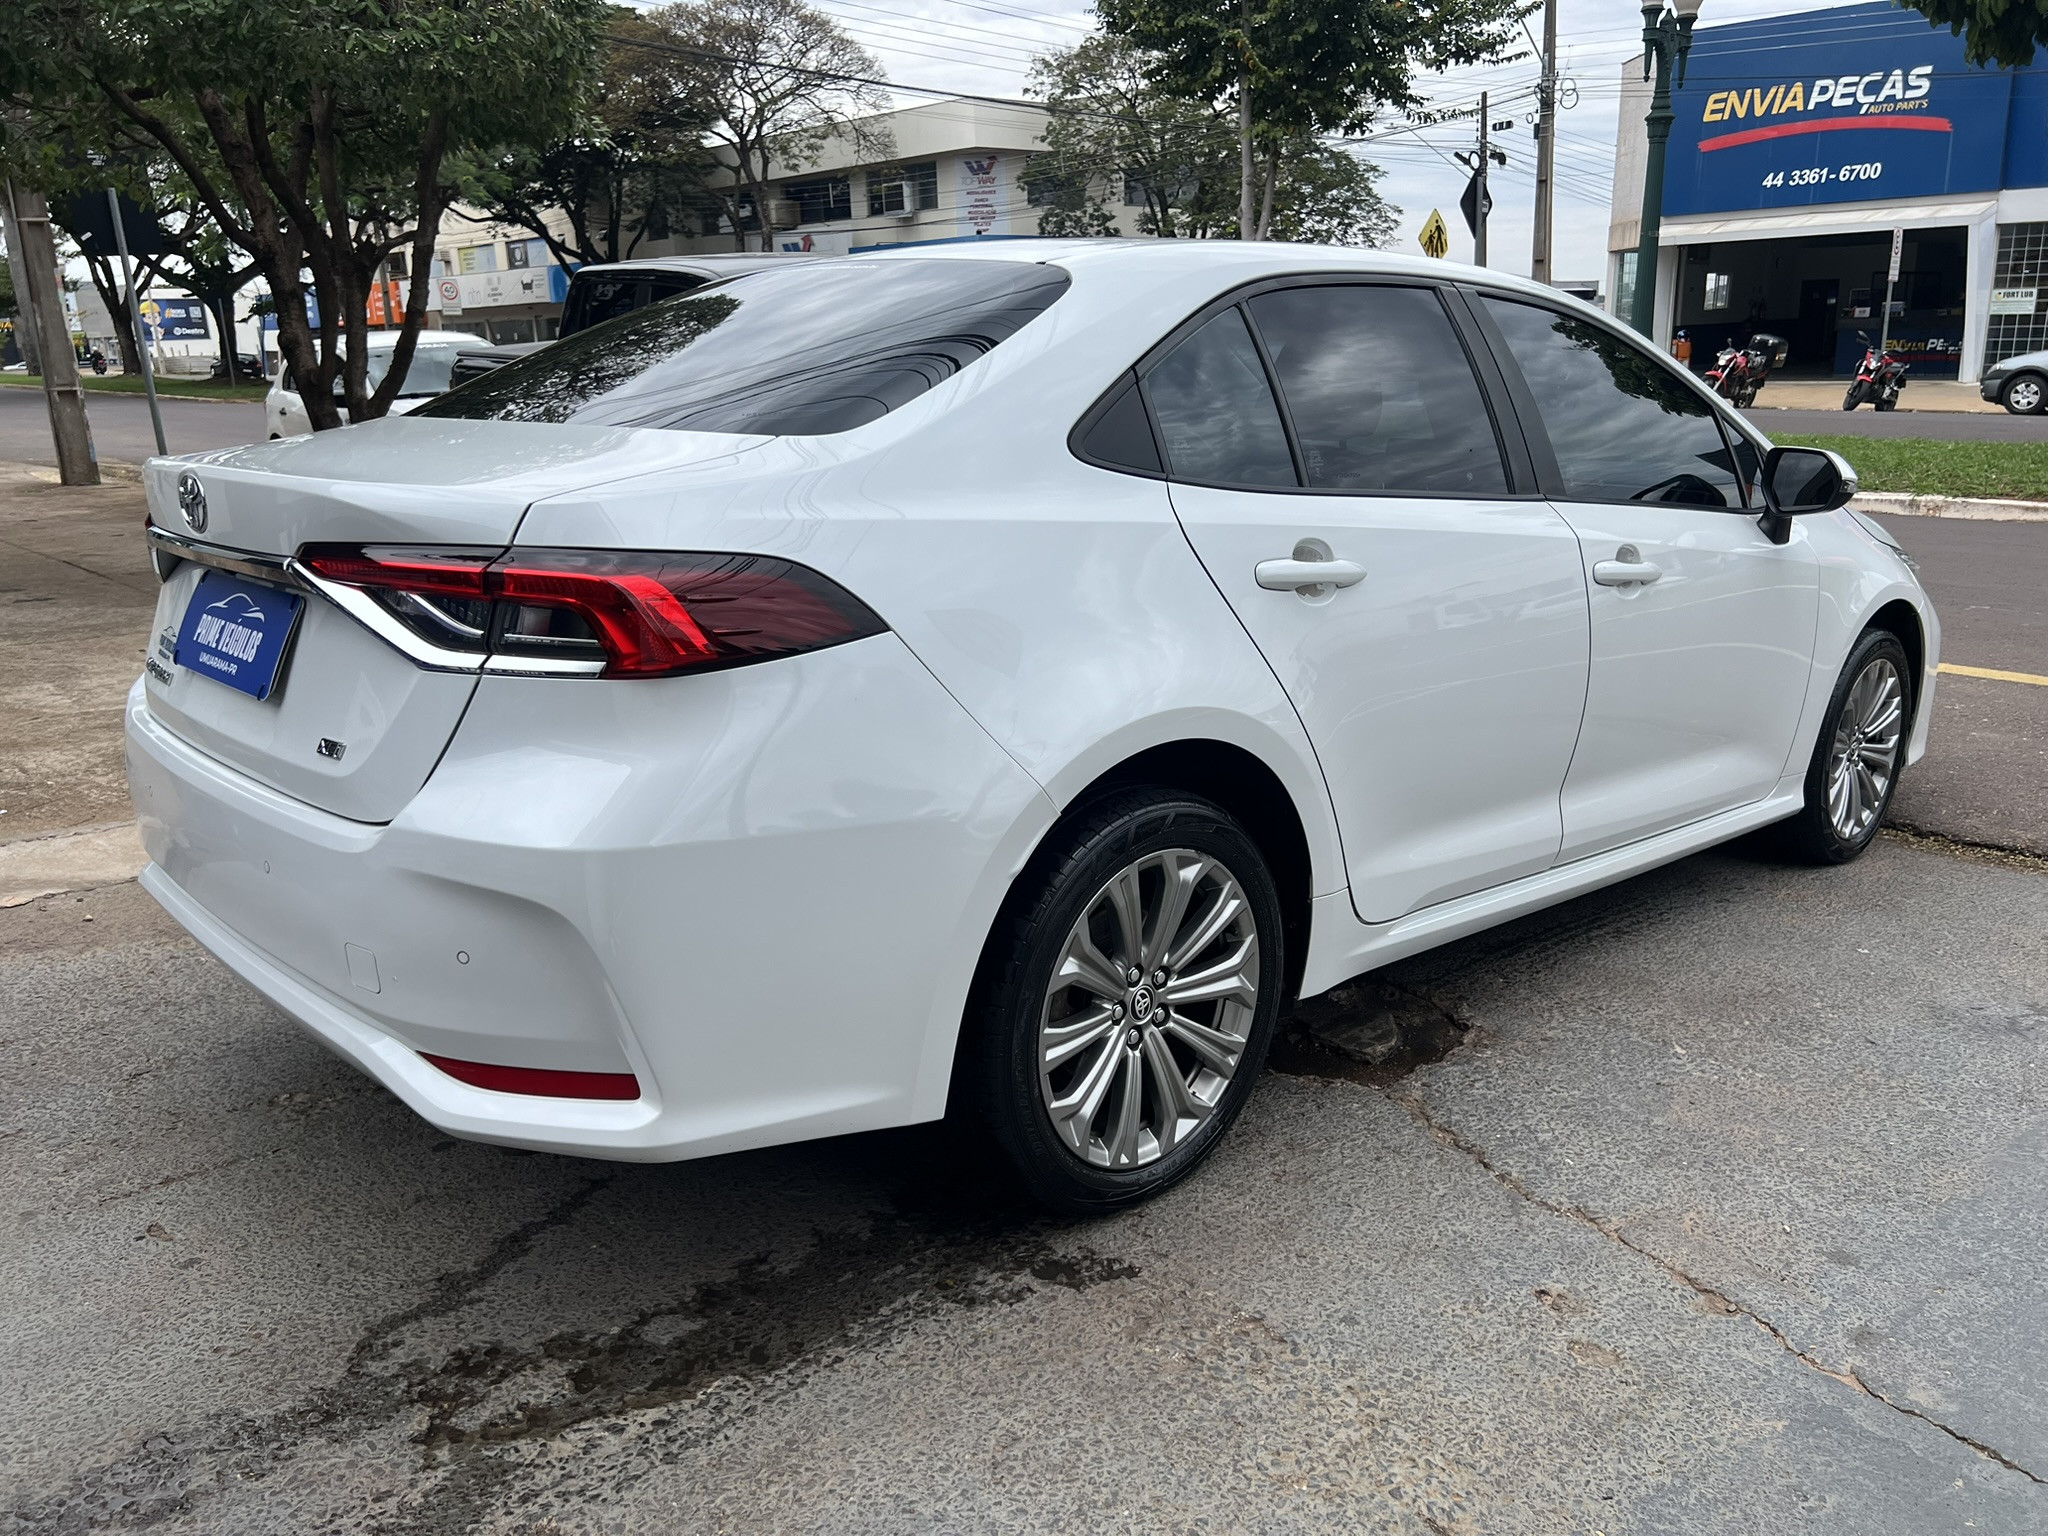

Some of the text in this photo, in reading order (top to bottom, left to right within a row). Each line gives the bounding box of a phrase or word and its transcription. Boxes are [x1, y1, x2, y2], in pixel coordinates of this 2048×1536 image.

[1702, 65, 1934, 122] ENVIA PEÇAS
[1868, 103, 1895, 114] AUTO
[1762, 172, 1784, 188] 44
[444, 286, 455, 294] 40
[193, 613, 226, 649] PRIME
[217, 617, 264, 664] VEÍCULOS
